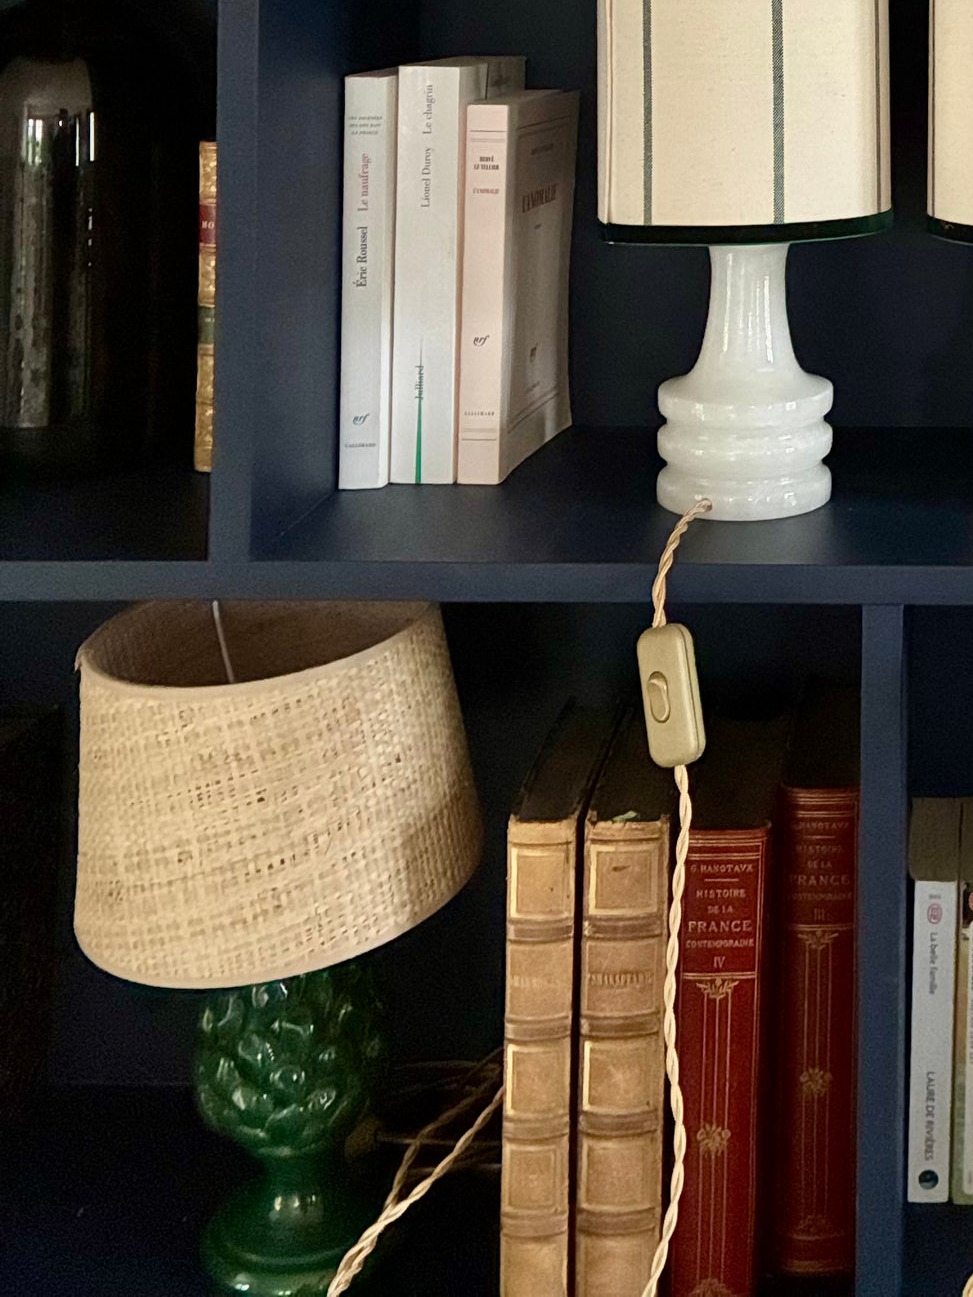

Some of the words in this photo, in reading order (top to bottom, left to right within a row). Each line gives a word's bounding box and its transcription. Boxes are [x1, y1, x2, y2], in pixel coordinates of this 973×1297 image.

[423, 84, 435, 121] chagrin
[422, 125, 433, 135] Le
[421, 146, 434, 176] Duroy
[357, 153, 371, 198] naufrage
[421, 177, 432, 208] Lionel
[357, 200, 369, 211] Le
[356, 226, 369, 264] Roussel
[352, 266, 368, 288] Éric
[472, 334, 490, 347] nrf
[696, 889, 746, 899] HISTOIRE
[707, 905, 719, 915] DE
[688, 920, 752, 933] FRANCE
[686, 939, 755, 949] CONTEMPORAINE
[929, 944, 939, 966] belle
[713, 956, 726, 969] IV
[928, 967, 939, 996] famille
[926, 1071, 936, 1100] LAURE
[925, 1102, 935, 1119] DE
[924, 1120, 937, 1162] RIVIÈRES
